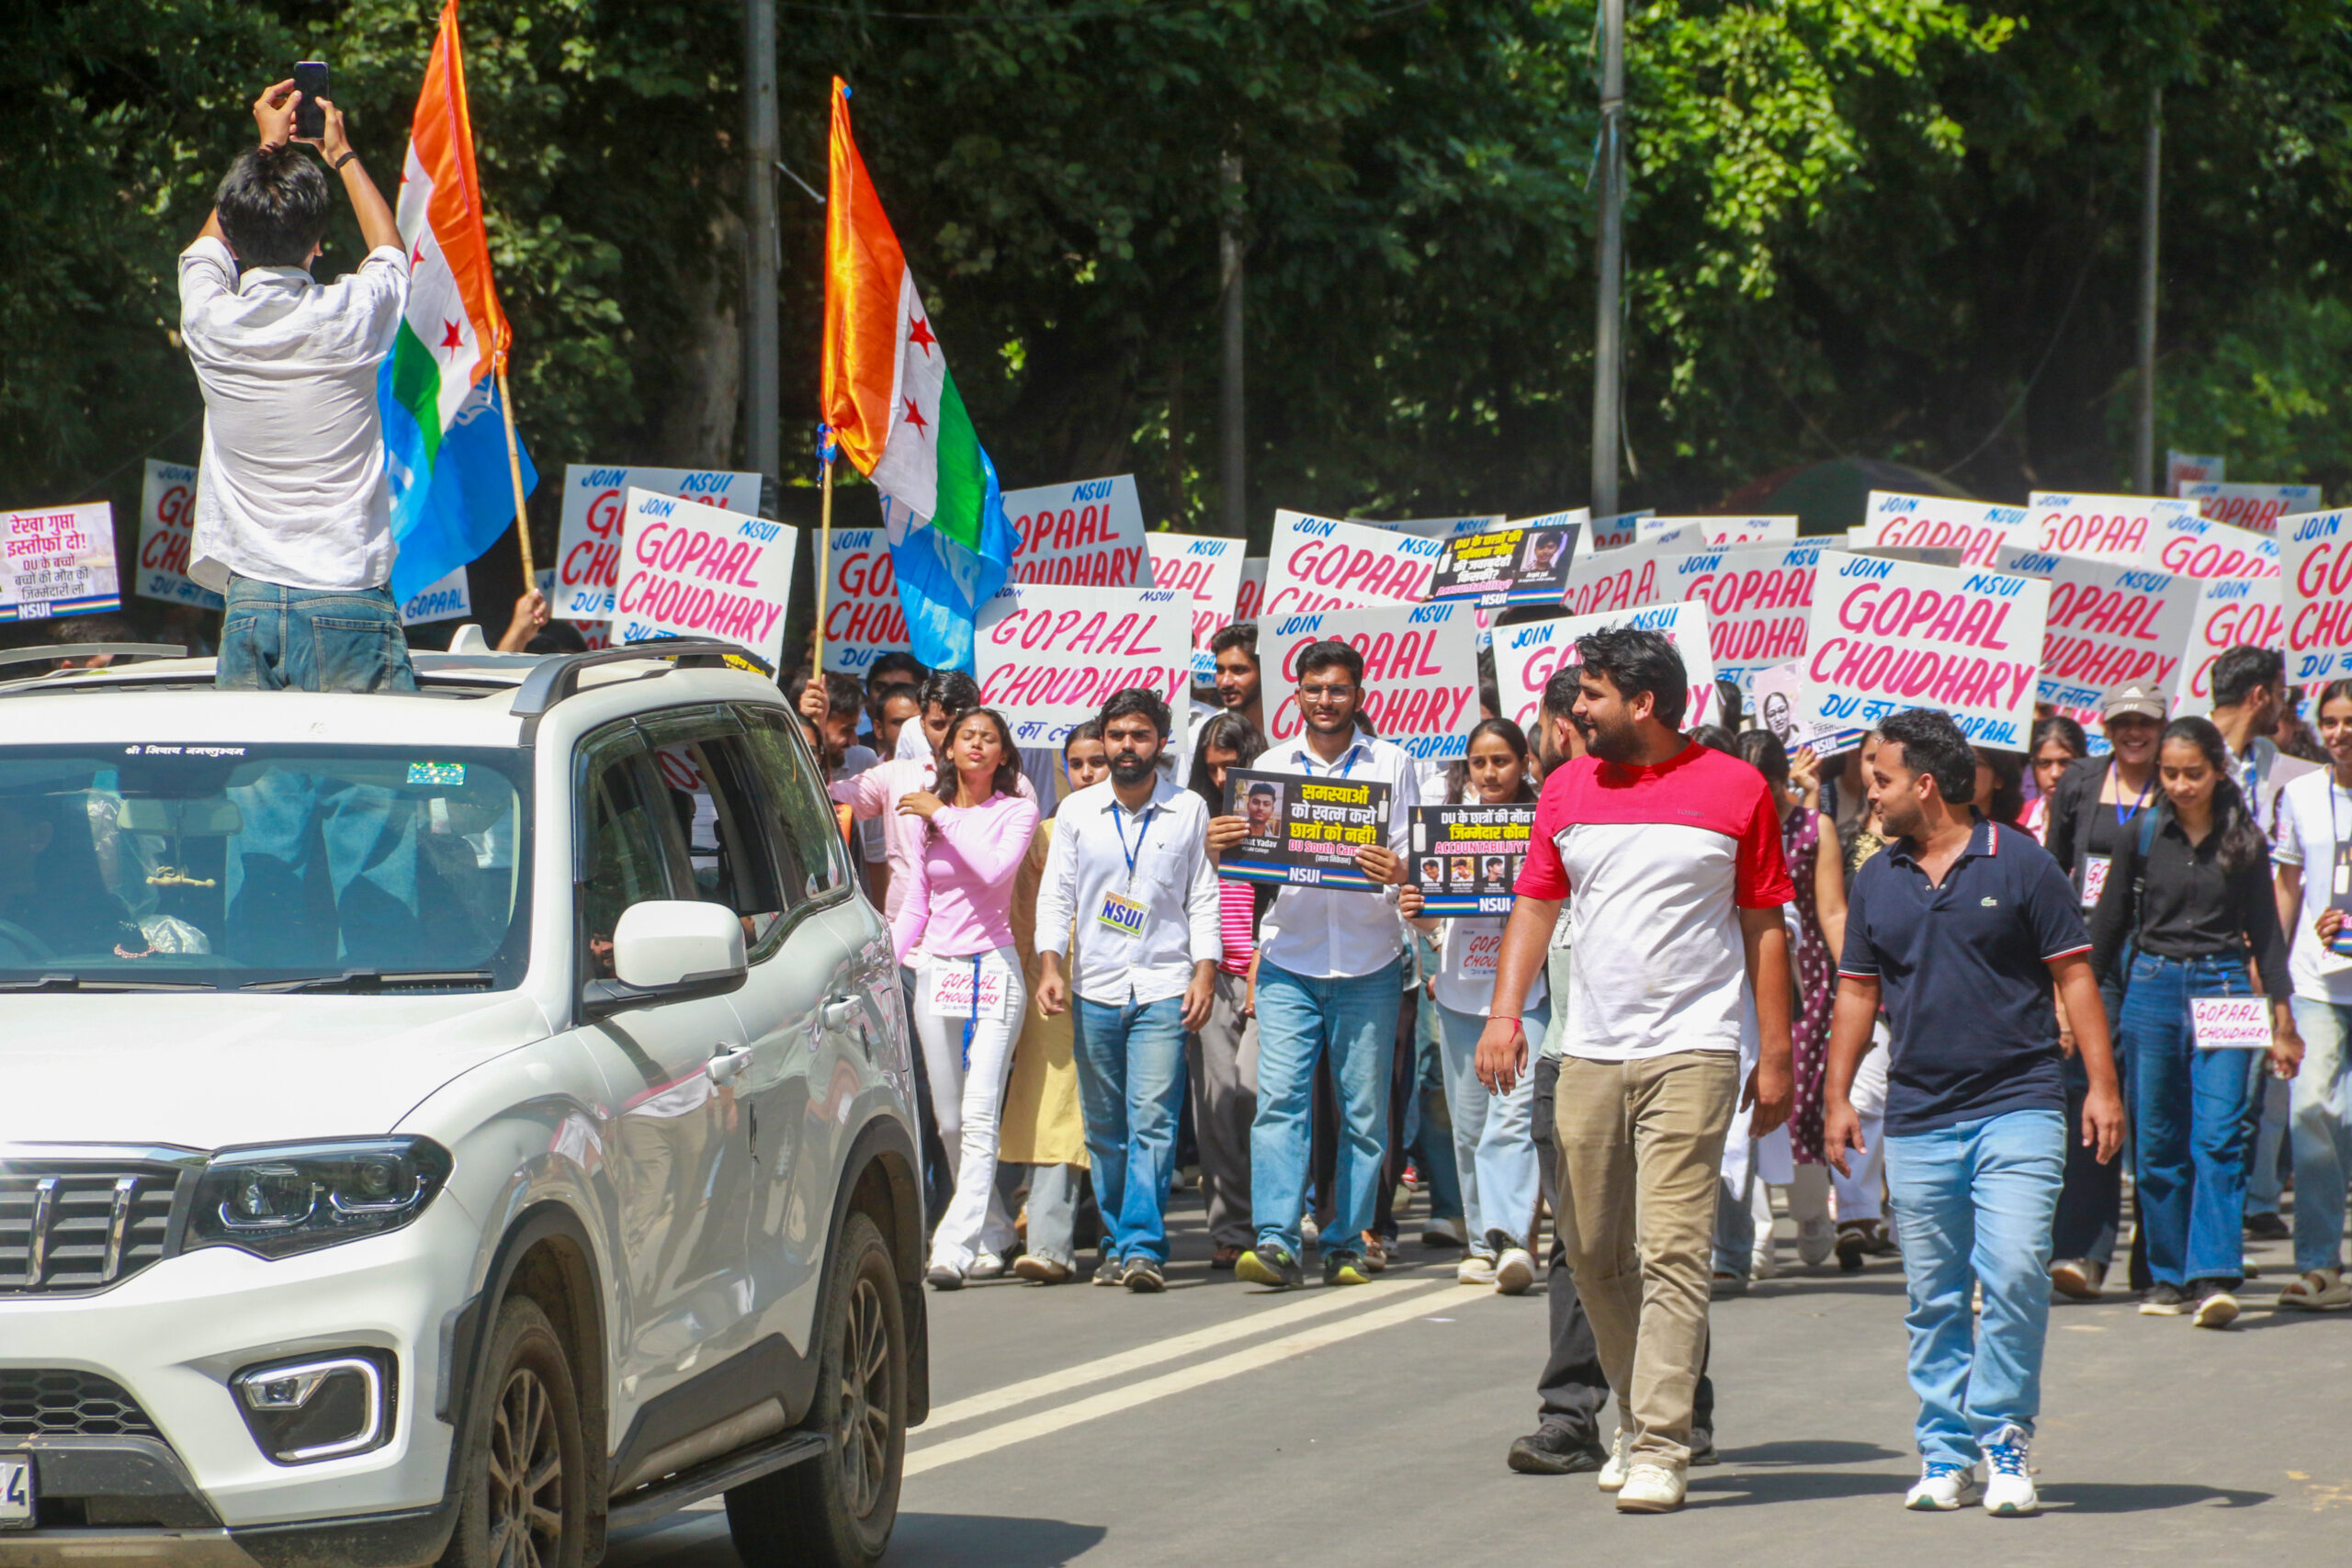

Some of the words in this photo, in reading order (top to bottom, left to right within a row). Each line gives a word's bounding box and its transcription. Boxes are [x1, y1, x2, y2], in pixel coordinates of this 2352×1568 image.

[157, 466, 196, 484] JOIN
[581, 468, 628, 489] JOIN
[680, 472, 735, 494] NSUI
[1071, 479, 1114, 502] NSUI
[2037, 495, 2073, 507] JOIN
[639, 498, 677, 519] JOIN
[737, 520, 781, 544] NSUI
[1879, 496, 1919, 513] JOIN
[1984, 507, 2029, 525] NSUI
[9, 513, 45, 535] रेखा
[47, 513, 75, 536] गुप्ता
[1011, 502, 1120, 558] OPAAL
[1292, 517, 1338, 538] JOIN
[2039, 512, 2150, 553] GOPAA
[2167, 513, 2212, 536] JOIN
[2292, 513, 2343, 542] JOIN
[64, 530, 86, 551] दो!
[831, 530, 874, 551] JOIN
[1186, 540, 1228, 558] NSUI
[1453, 538, 1471, 550] DU
[23, 558, 39, 571] DU
[40, 555, 51, 570] के
[636, 521, 764, 589] GOPAAL
[1013, 545, 1143, 587] OUDHARY
[1678, 554, 1724, 575] JOIN
[1781, 547, 1818, 567] NSU
[39, 569, 51, 584] की
[54, 568, 74, 582] मौत
[76, 565, 89, 581] की
[1287, 539, 1433, 604] GOPAAL
[1839, 557, 1895, 580] JOIN
[1962, 573, 2026, 597] NSUI
[2009, 553, 2061, 574] JOIN
[2115, 570, 2172, 592] NSUI
[150, 575, 176, 595] DU
[994, 587, 1024, 598] JOIN
[1138, 591, 1175, 603] NSUI
[2206, 580, 2251, 599] JOIN
[17, 601, 52, 620] NSUI
[405, 588, 467, 619] GOPAAL
[571, 592, 602, 614] DU
[618, 570, 784, 644] CHOUDHARY
[1480, 592, 1509, 606] NSUI
[1276, 615, 1324, 637] JOIN
[1408, 604, 1454, 624] NSUI
[1838, 581, 2012, 651] GOPAAL
[2046, 581, 2165, 641] OPAAL
[990, 607, 1162, 656] GOPAAL
[1510, 624, 1555, 650] JOIN
[1632, 607, 1679, 630] NSUI
[839, 647, 873, 667] DU
[2297, 652, 2335, 678] DU
[1808, 637, 2036, 713] CHOUDHARY
[1271, 685, 1475, 740] CDHARY
[1818, 693, 1861, 719] DU
[125, 744, 141, 755] श्री
[1404, 734, 1468, 759] GOPAA
[1301, 783, 1370, 805] समस्याओं
[1290, 800, 1309, 819] को
[1312, 805, 1348, 823] खत्म
[1349, 805, 1377, 825] करो
[1441, 812, 1455, 825] DU
[1457, 809, 1469, 824] के
[1469, 808, 1494, 824] छात्रों
[1494, 807, 1509, 823] की
[1509, 808, 1531, 824] मौत
[1289, 820, 1322, 840] छात्रों
[1323, 821, 1343, 840] को
[1344, 824, 1377, 844] नहीं!
[1448, 823, 1502, 840] जिम्मेदार
[1502, 822, 1531, 840] कौन
[1256, 838, 1278, 849] Yadav
[1288, 839, 1305, 852] DU
[1304, 840, 1335, 855] South
[1336, 843, 1358, 857] Cam
[1434, 840, 1523, 855] ACCOUNTABILITY
[1288, 866, 1321, 884] NSUI
[1101, 899, 1144, 931] NSUI
[1478, 897, 1511, 912] NSUI
[1468, 935, 1502, 953] GOP
[934, 990, 1001, 1006] CHOUDARY
[2195, 1001, 2261, 1025] GOPAAL
[2197, 1025, 2270, 1041] CHOUDHARY
